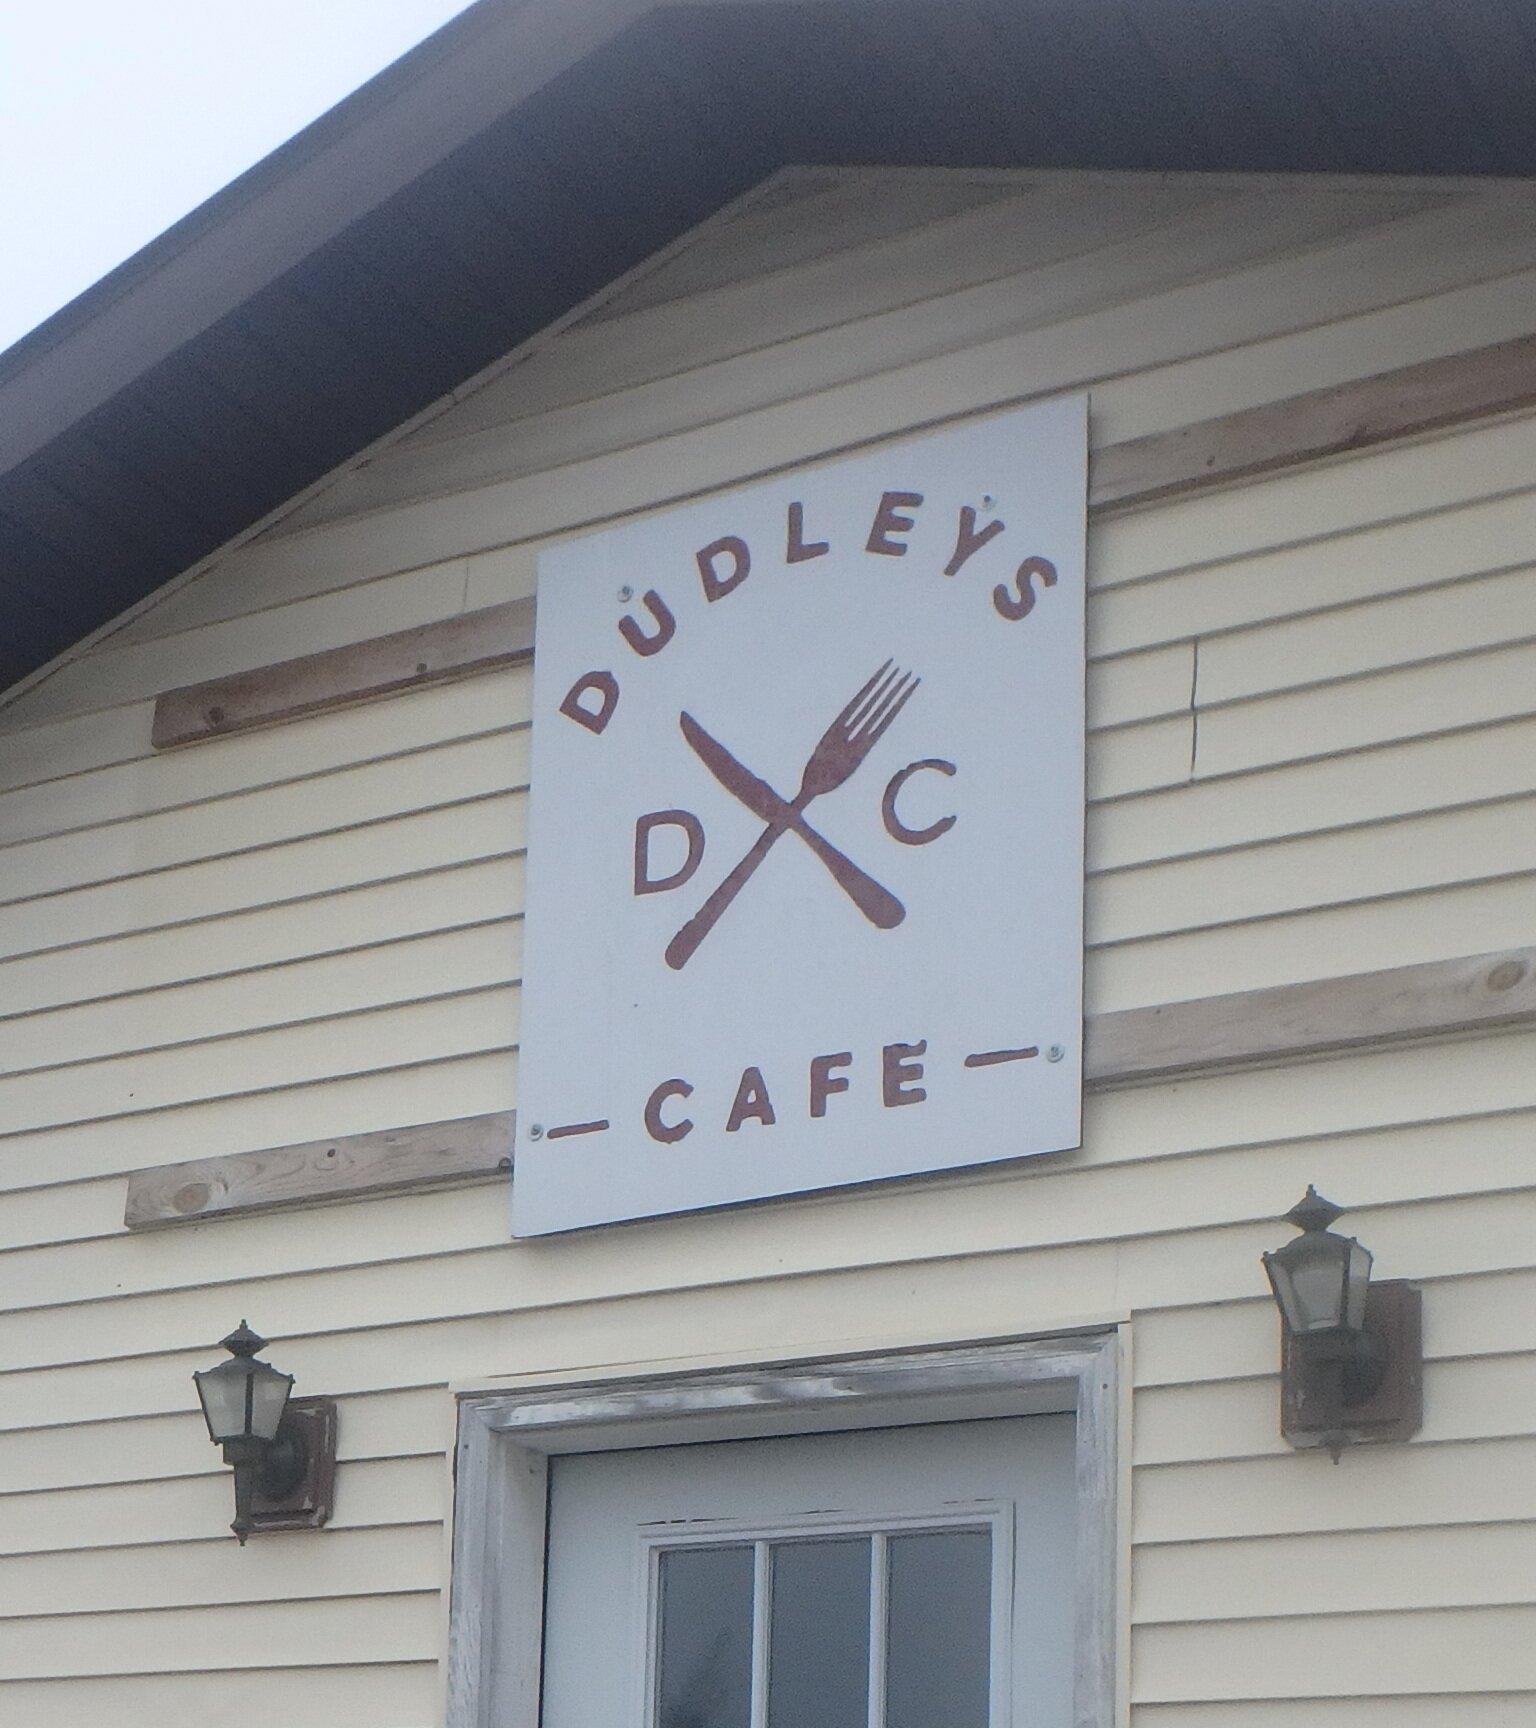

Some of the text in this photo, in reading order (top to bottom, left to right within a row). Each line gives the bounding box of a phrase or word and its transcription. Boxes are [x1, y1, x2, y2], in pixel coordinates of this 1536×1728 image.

[559, 491, 1058, 736] DUDLEYS
[632, 758, 958, 896] D C
[643, 1038, 929, 1145] CAFE
